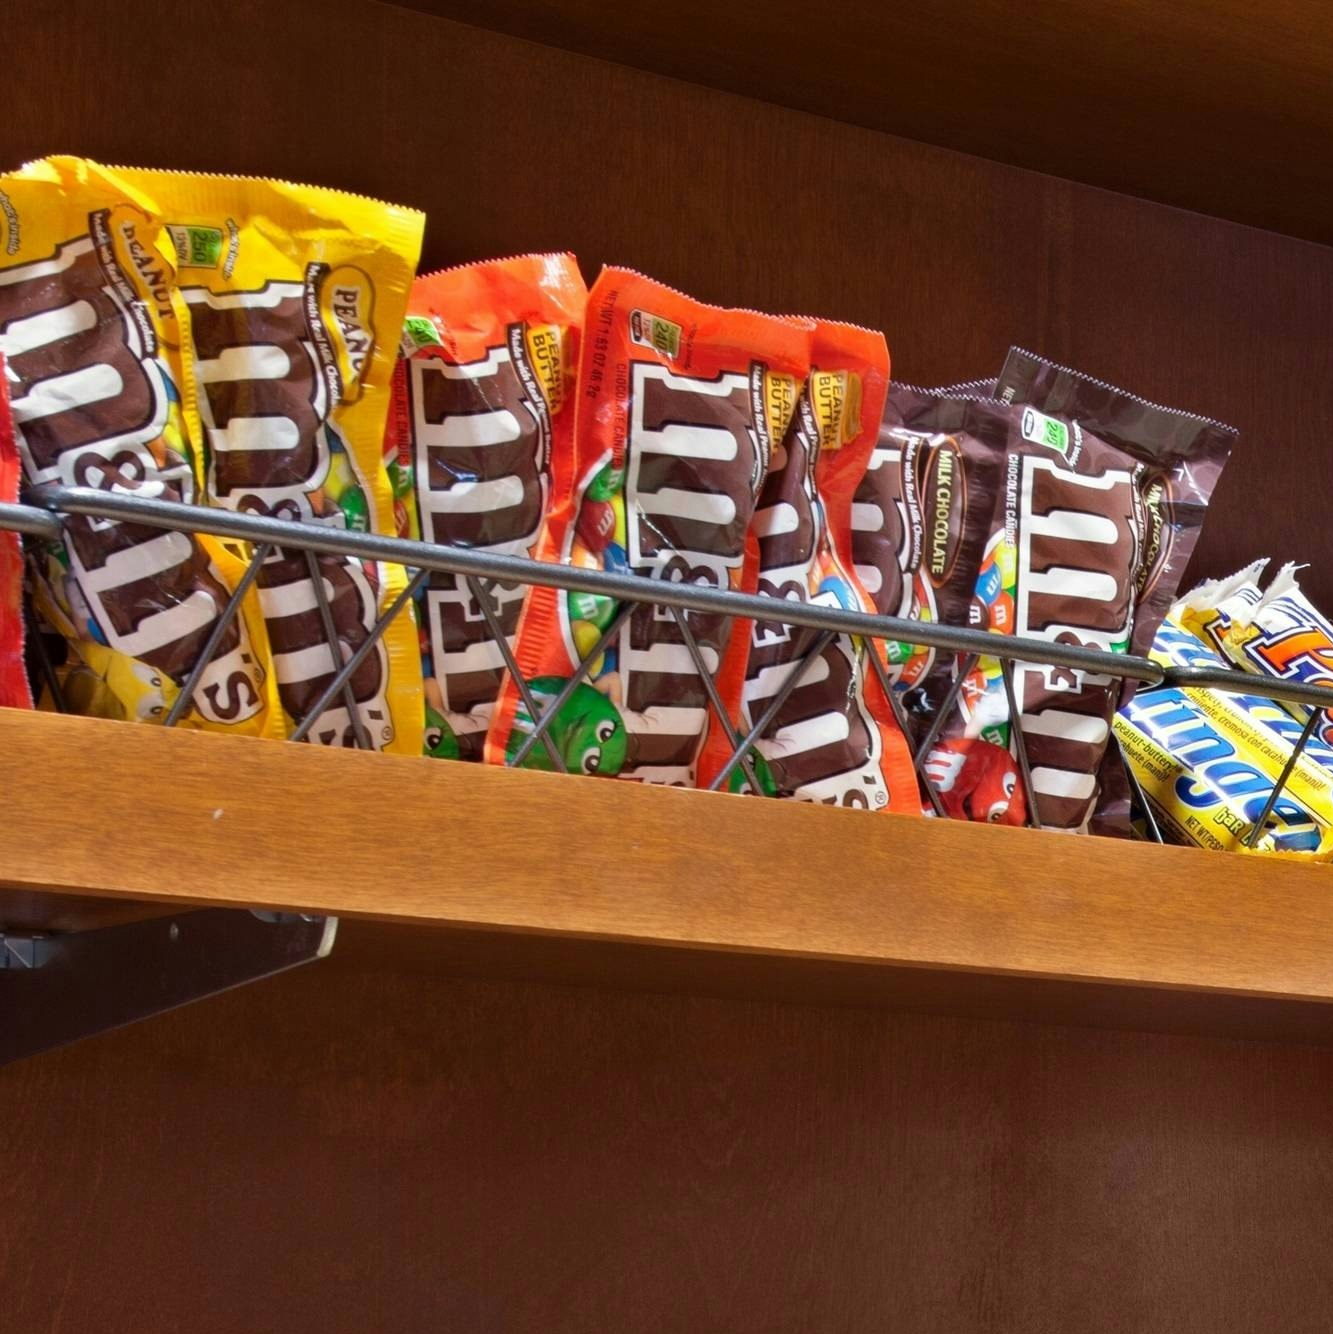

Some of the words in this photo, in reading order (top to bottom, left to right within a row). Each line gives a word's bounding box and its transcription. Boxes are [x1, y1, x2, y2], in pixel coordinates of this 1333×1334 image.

[817, 374, 833, 449] BUTTER
[938, 449, 953, 477] MILK
[1005, 453, 1019, 507] CHOCOLATE
[910, 523, 925, 571] Chocolate
[931, 478, 952, 576] CHOCOLATE
